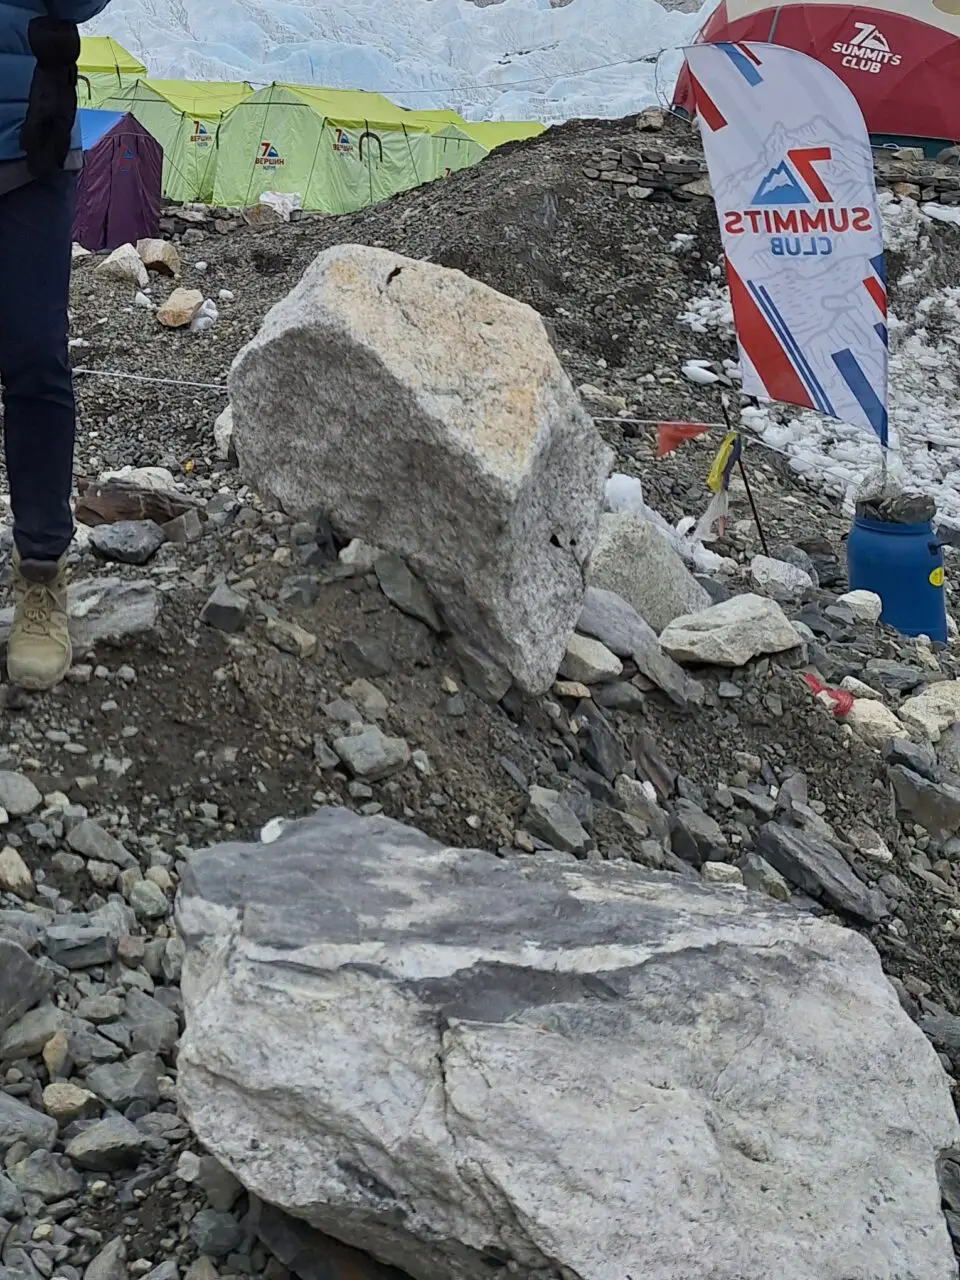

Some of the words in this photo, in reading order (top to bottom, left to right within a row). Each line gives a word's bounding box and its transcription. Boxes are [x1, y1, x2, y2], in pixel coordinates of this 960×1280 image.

[849, 22, 877, 46] 7
[831, 42, 902, 66] SUMMITS
[841, 56, 882, 74] CLUB
[260, 142, 271, 157] 7
